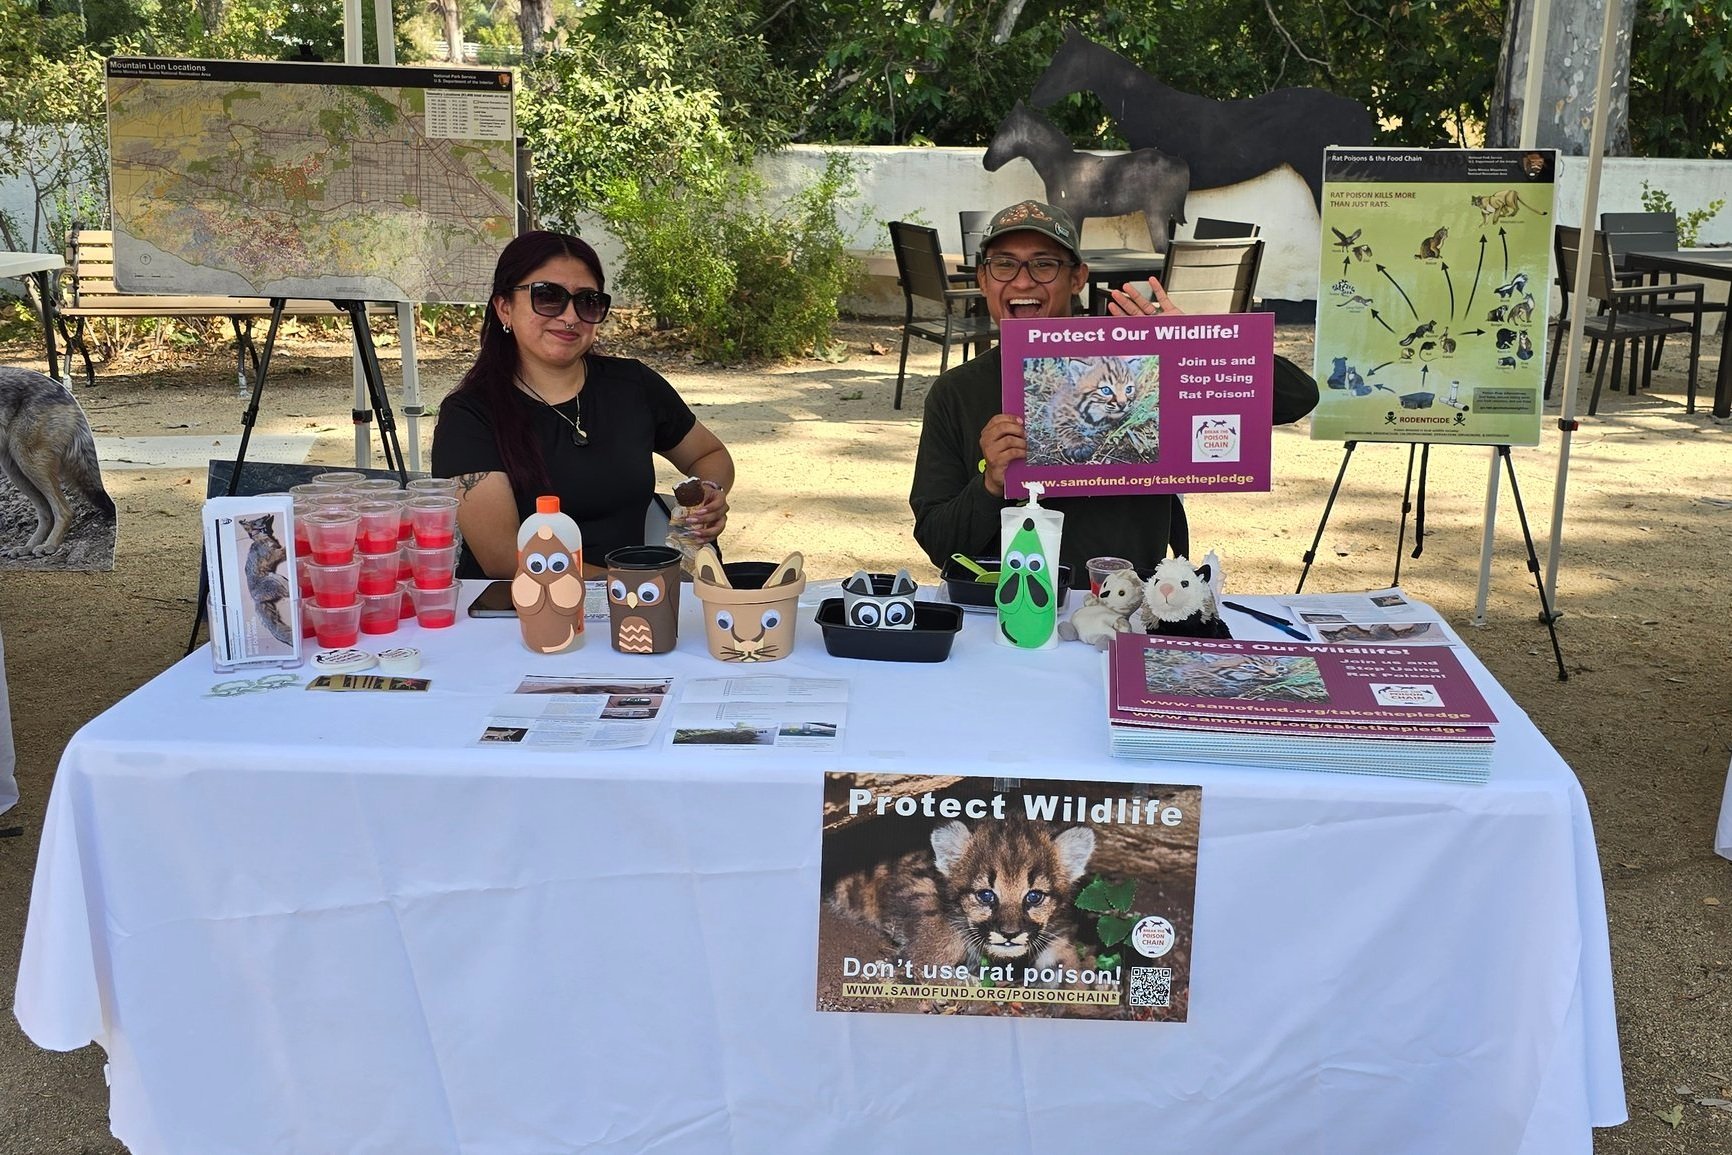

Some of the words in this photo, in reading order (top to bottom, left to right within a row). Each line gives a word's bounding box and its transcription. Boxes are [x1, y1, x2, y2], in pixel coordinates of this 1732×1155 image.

[110, 61, 146, 70] Mountain
[168, 64, 206, 72] Locations
[1028, 328, 1105, 343] Protect
[1111, 327, 1149, 342] Our
[1154, 325, 1239, 340] Wildlife!
[1178, 356, 1207, 367] Join
[1211, 358, 1226, 367] us
[1230, 356, 1256, 366] and
[1180, 374, 1211, 385] Stop
[1214, 373, 1253, 385] Using
[1179, 390, 1202, 399] Rat
[1206, 390, 1255, 399] Poison!
[1021, 474, 1254, 488] w.samofund.org/takethepledge
[1150, 638, 1244, 649] Protect
[1252, 644, 1297, 652] Our
[1304, 646, 1410, 655] Wildlife!
[1140, 699, 1471, 719] www.samofund.org/takethepledge
[1133, 712, 1467, 733] www.samofund.org/takethepledge
[849, 788, 1006, 820] Protect
[1023, 794, 1184, 827] Wildlife
[843, 956, 914, 979] Don’t
[923, 963, 969, 980] use
[979, 962, 1014, 982] rat
[1024, 966, 1122, 986] poison!
[846, 984, 1110, 1003] WWW.SAMOFUND.ORG/POISONCHAIN
